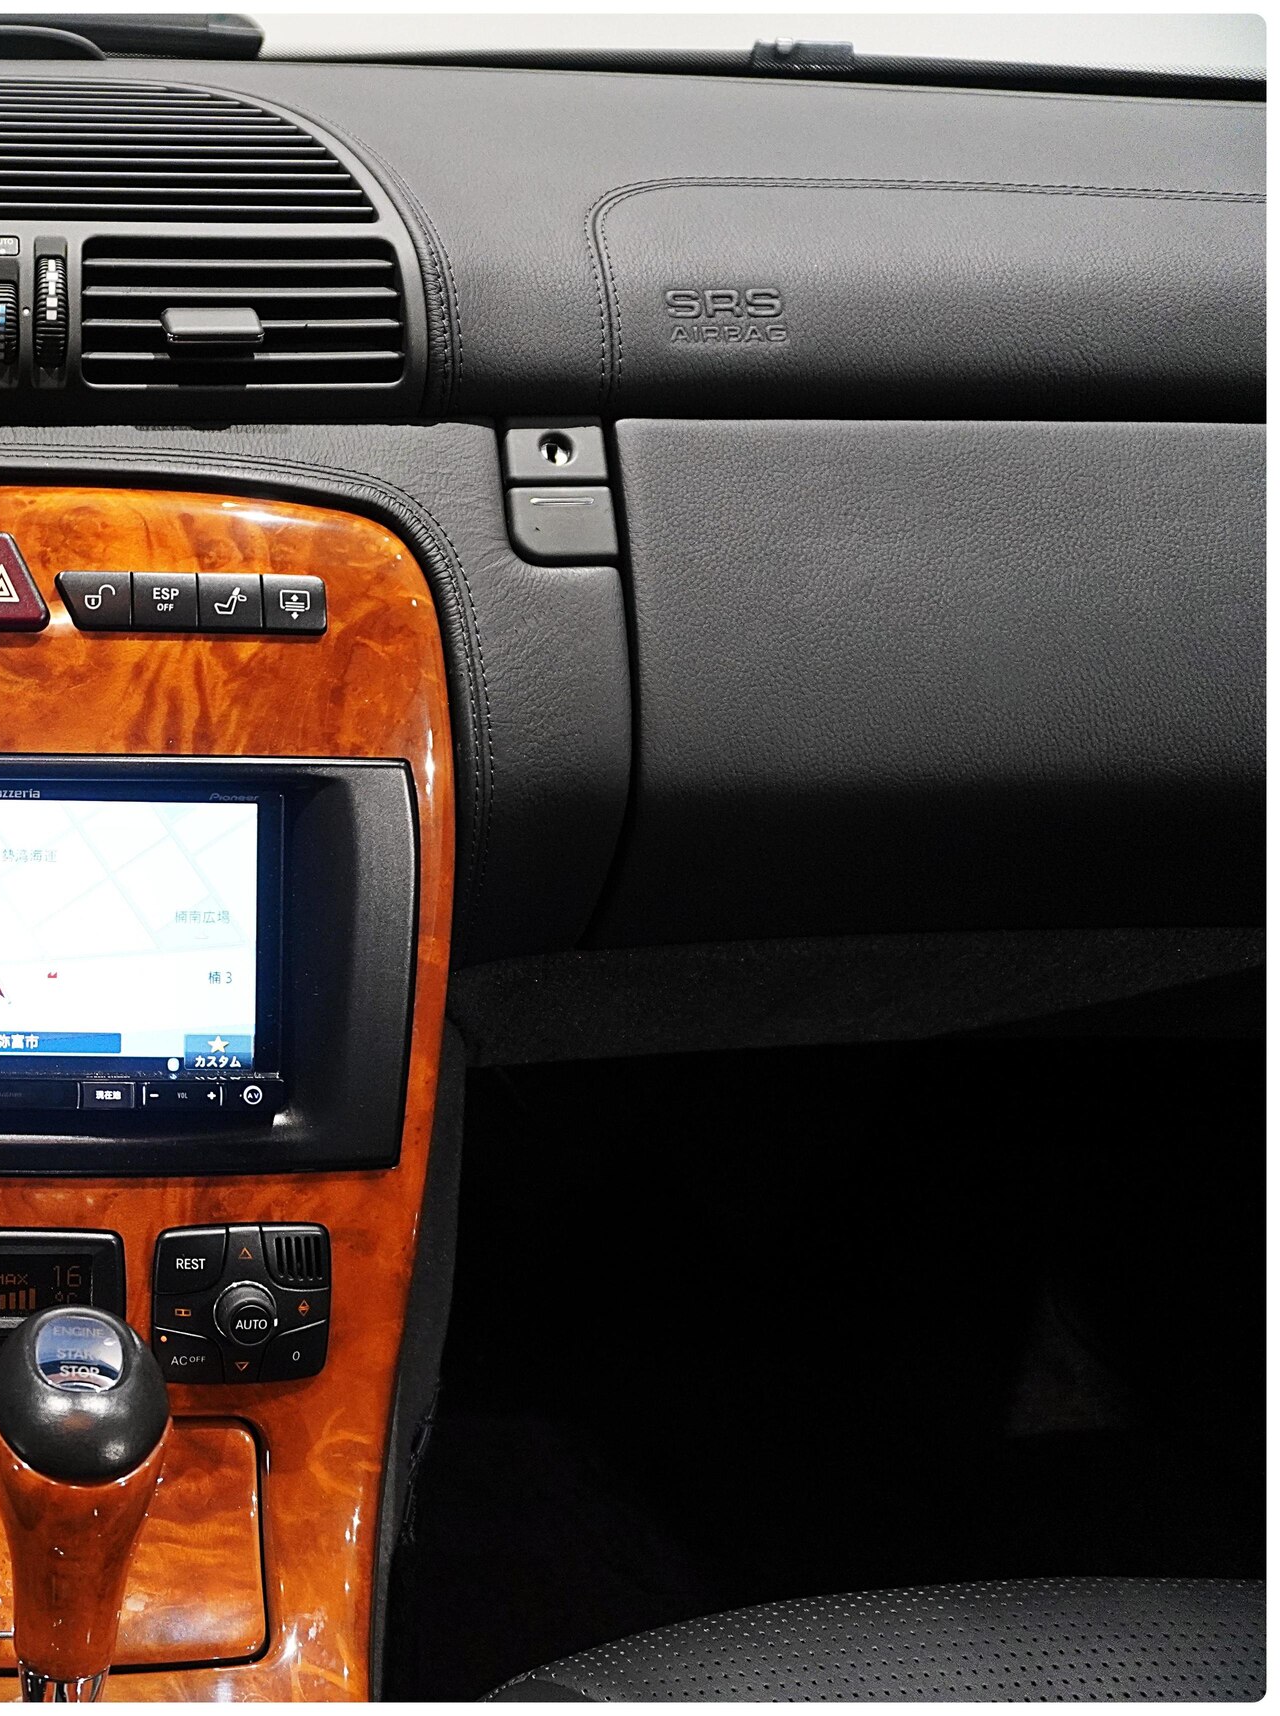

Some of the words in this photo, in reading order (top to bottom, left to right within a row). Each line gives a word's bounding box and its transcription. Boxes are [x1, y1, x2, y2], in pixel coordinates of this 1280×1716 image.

[666, 289, 783, 318] SRS
[670, 325, 787, 343] AIRBAG
[153, 587, 179, 600] ESP
[156, 603, 174, 612] OFF
[174, 910, 232, 925] 楠南広場
[194, 1055, 242, 1069] カスタム
[176, 1258, 206, 1270] REST
[53, 1265, 82, 1288] 16
[235, 1319, 268, 1330] AUTO
[53, 1325, 104, 1338] ENGINE
[170, 1356, 188, 1366] AC
[60, 1365, 100, 1378] STOP
